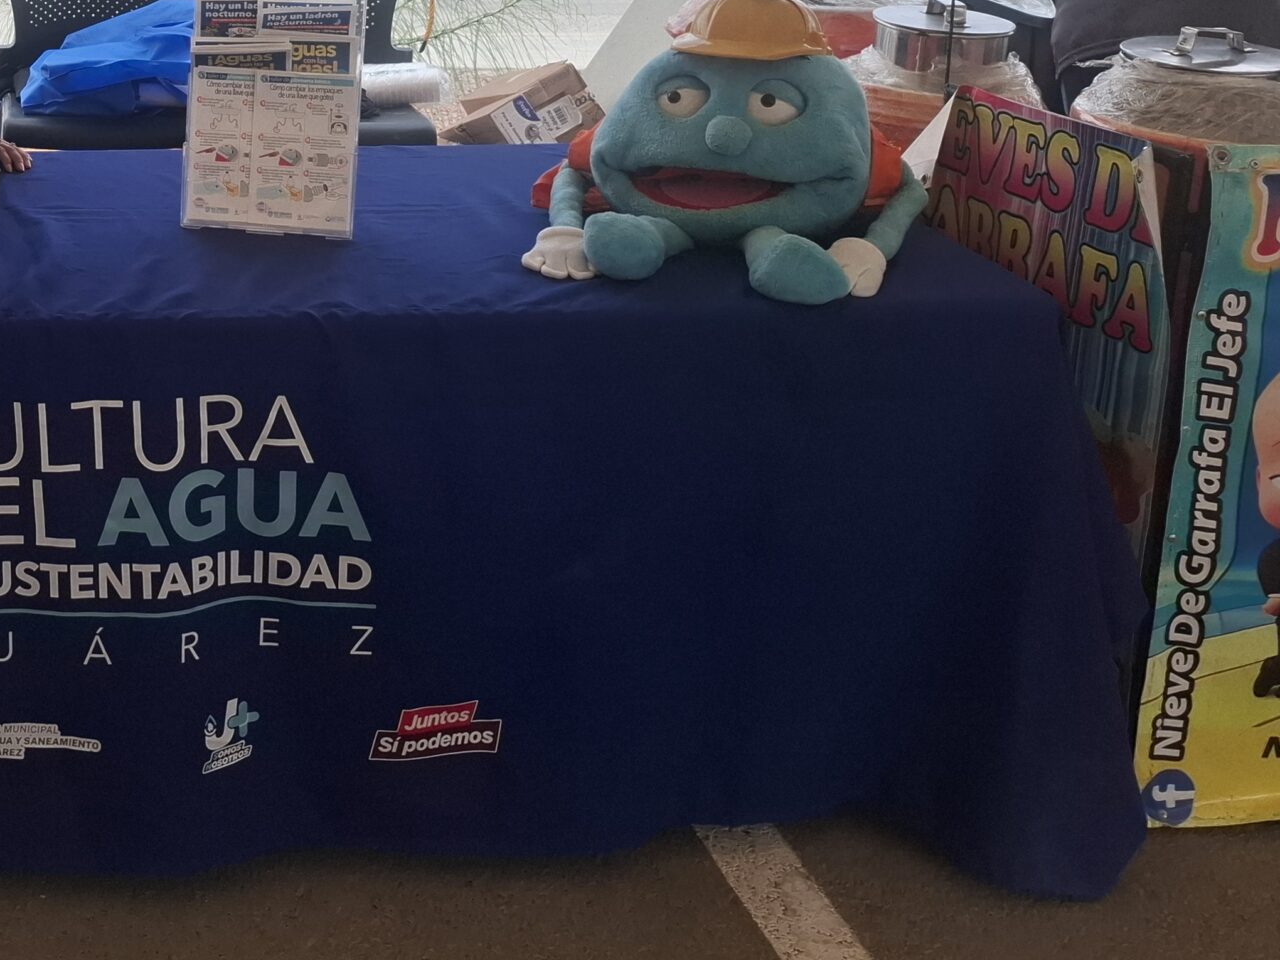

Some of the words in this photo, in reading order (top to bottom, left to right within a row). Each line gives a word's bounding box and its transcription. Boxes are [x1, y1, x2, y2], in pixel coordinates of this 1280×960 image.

[206, 2, 226, 10] Hay
[267, 14, 288, 22] Hay
[292, 44, 337, 60] guas
[938, 95, 1080, 213] EVES
[925, 184, 1153, 355] ARRAFA
[1207, 293, 1247, 375] Jefe
[1198, 384, 1234, 418] El
[97, 468, 372, 547] AGUA
[1179, 427, 1226, 582] Garrafa
[1169, 591, 1206, 642] De
[1153, 651, 1194, 757] Nieve
[4, 725, 59, 735] MUNICIPAL
[404, 708, 471, 732] Juntos
[24, 737, 100, 750] SANEAMIENTO
[378, 736, 400, 754] Sí
[402, 729, 494, 756] podemos
[206, 748, 250, 771] NOSOTROS
